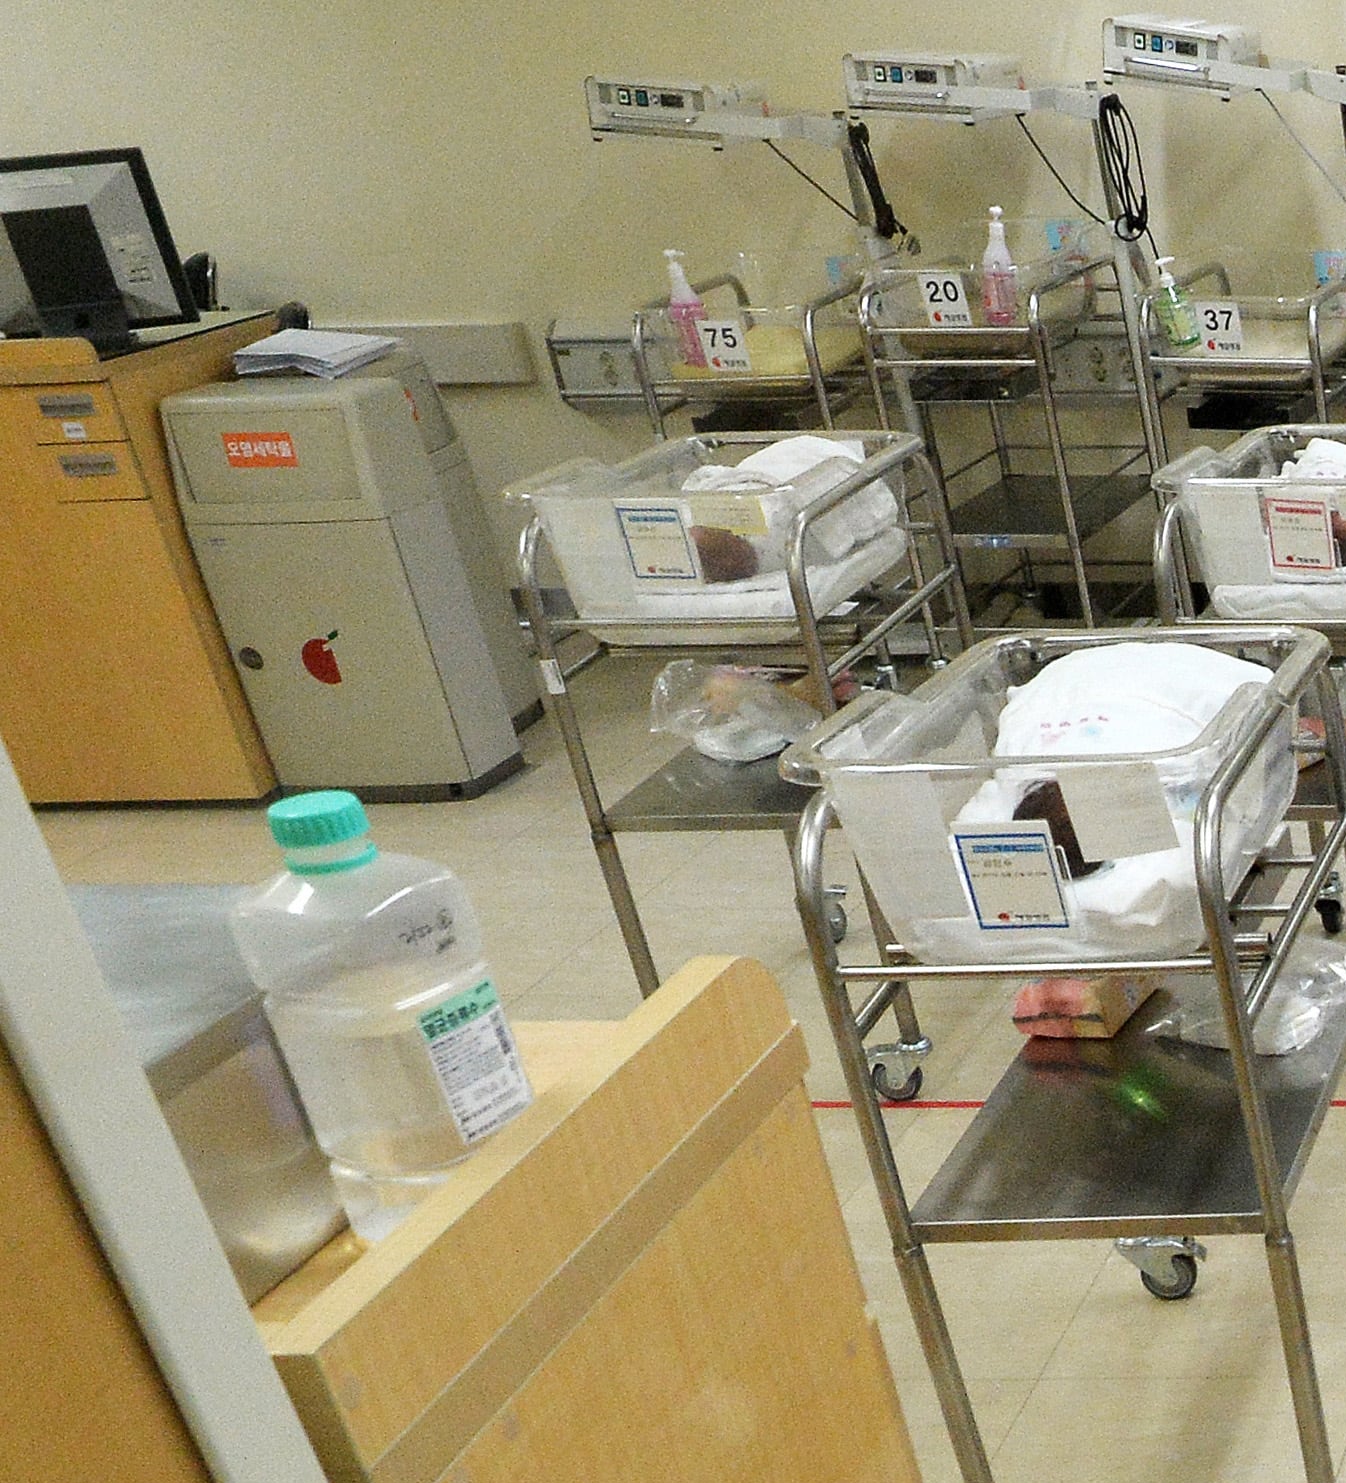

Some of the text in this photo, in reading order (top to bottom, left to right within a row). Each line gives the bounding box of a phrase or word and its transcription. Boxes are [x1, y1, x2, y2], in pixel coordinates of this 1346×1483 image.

[926, 281, 958, 302] 20
[1204, 309, 1233, 331] 37
[704, 328, 737, 348] 75
